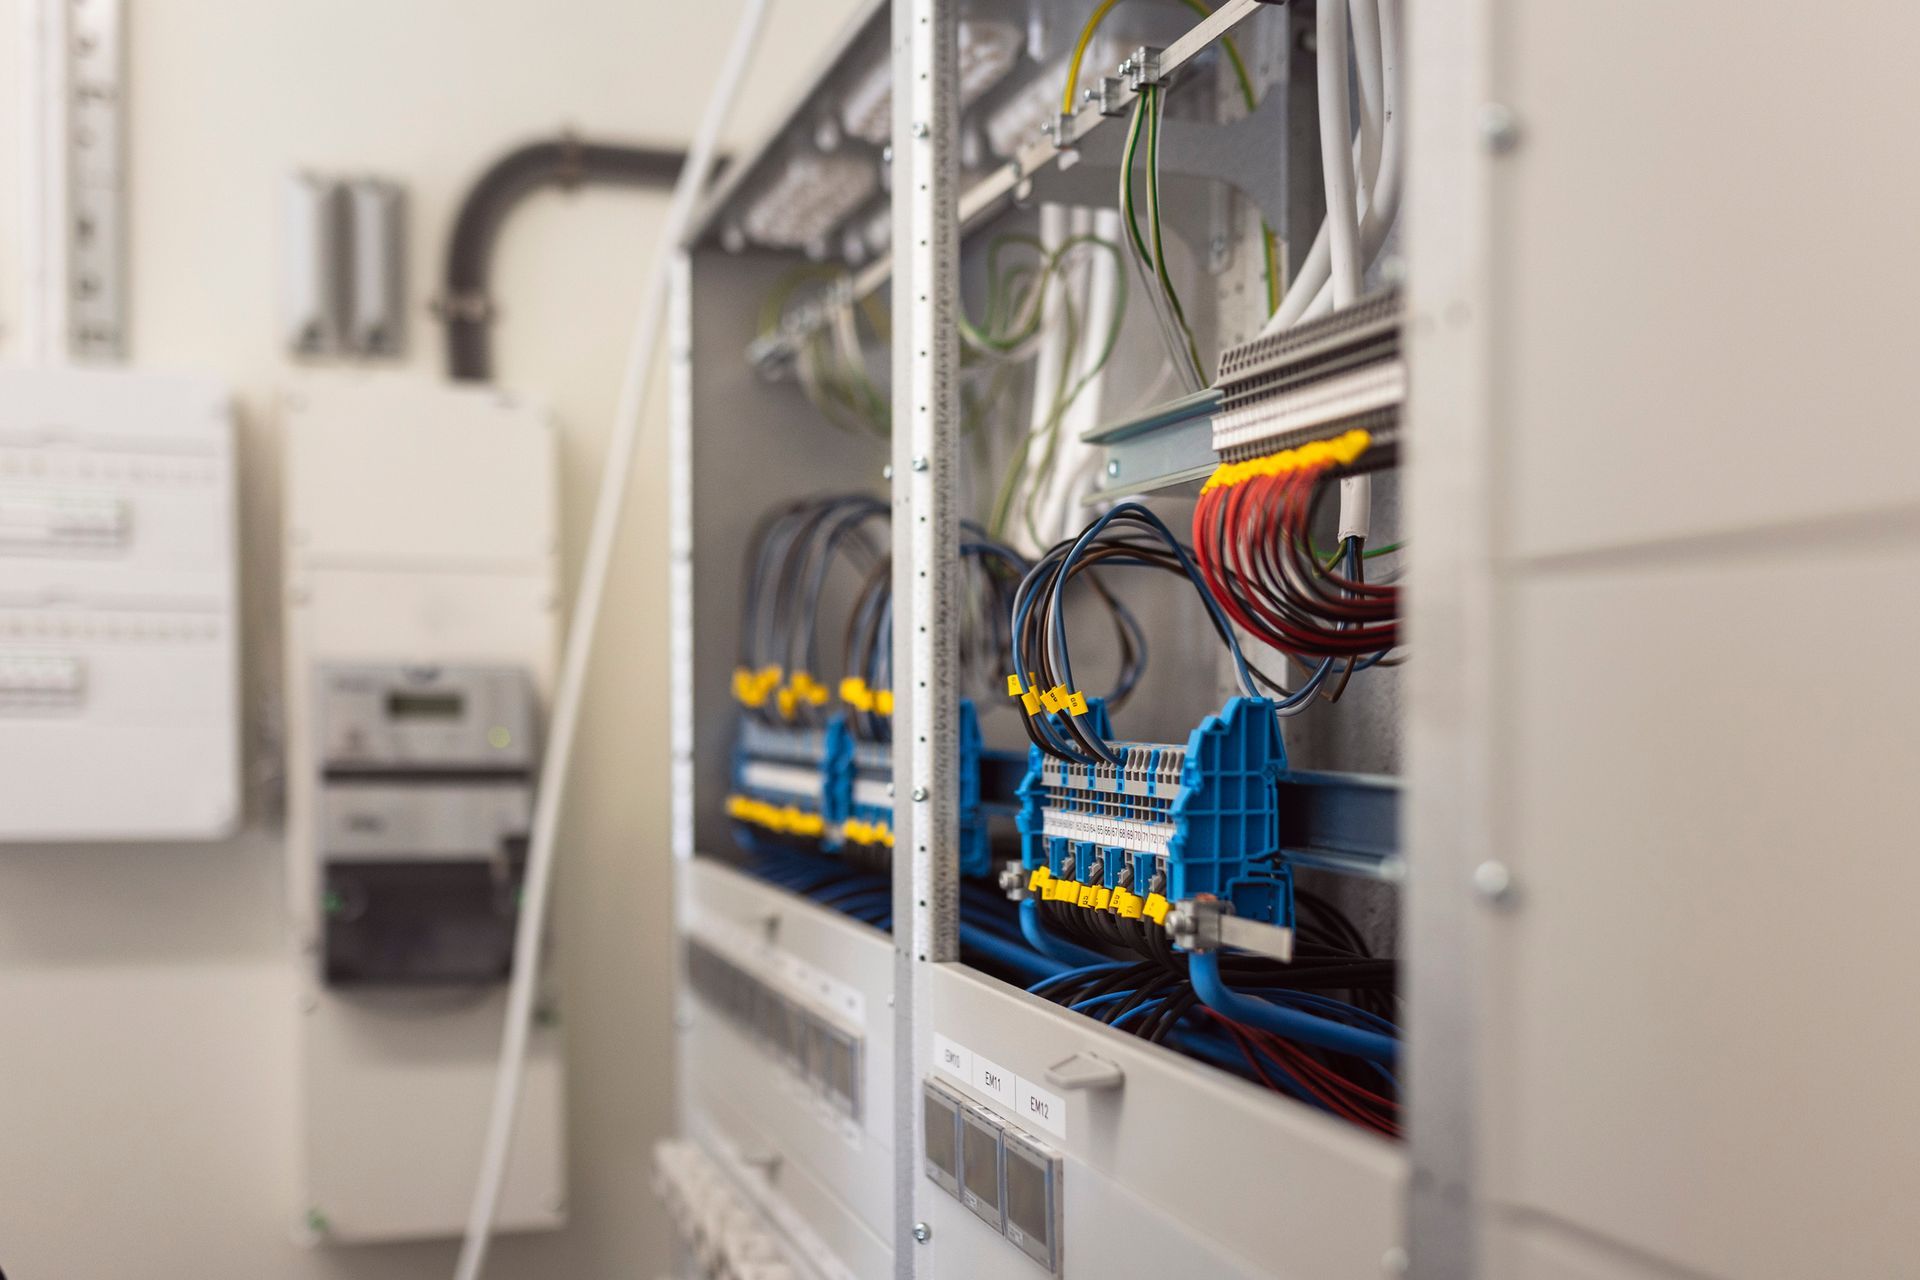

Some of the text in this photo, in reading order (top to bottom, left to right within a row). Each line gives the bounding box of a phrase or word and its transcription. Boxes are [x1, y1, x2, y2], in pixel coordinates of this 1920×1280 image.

[1097, 825, 1103, 835] 65
[1105, 826, 1111, 836] 66
[1112, 827, 1118, 837] 67
[1127, 830, 1133, 840] 69
[1135, 831, 1141, 841] 70
[1143, 832, 1149, 842] 71
[1150, 833, 1156, 844] 72
[985, 1071, 1001, 1092] EM11
[1030, 1096, 1049, 1120] EM12
